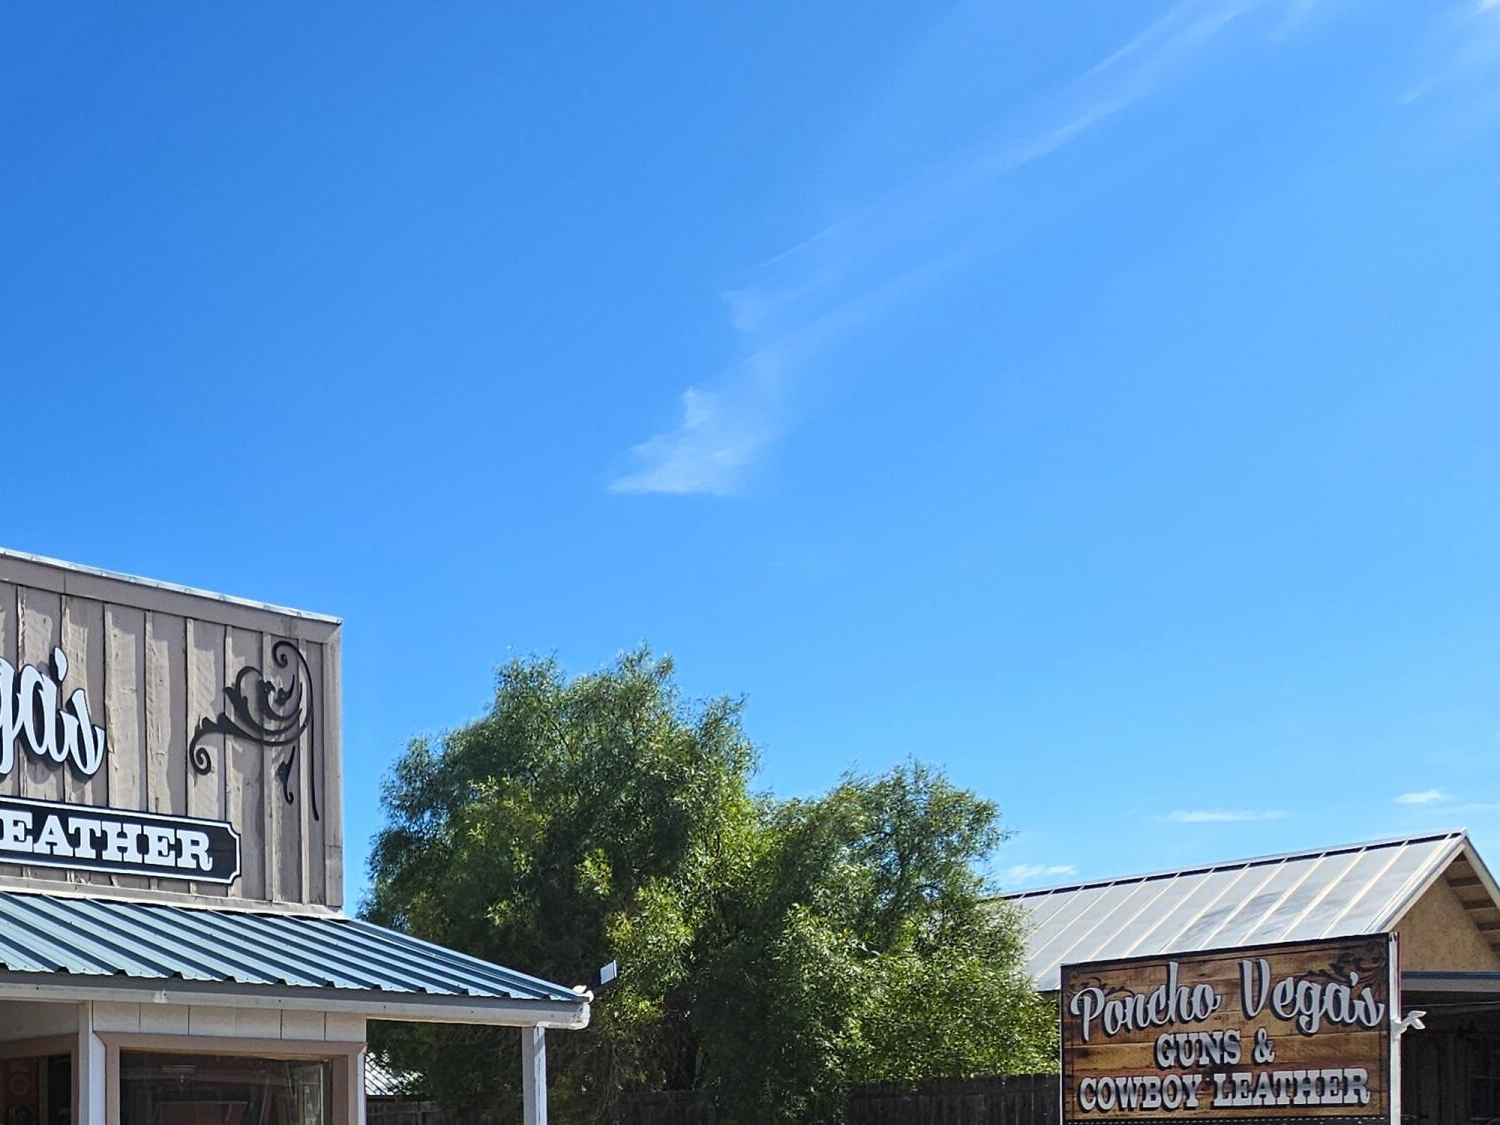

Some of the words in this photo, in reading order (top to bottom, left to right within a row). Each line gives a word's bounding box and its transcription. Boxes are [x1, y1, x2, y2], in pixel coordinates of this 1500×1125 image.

[1071, 960, 1221, 1042] Poncho
[1239, 958, 1386, 1035] Vega's
[1156, 1030, 1242, 1068] GUNS
[1254, 1027, 1275, 1064] &
[1079, 1074, 1202, 1111] COWBOY
[1213, 1068, 1371, 1107] LEATHER
